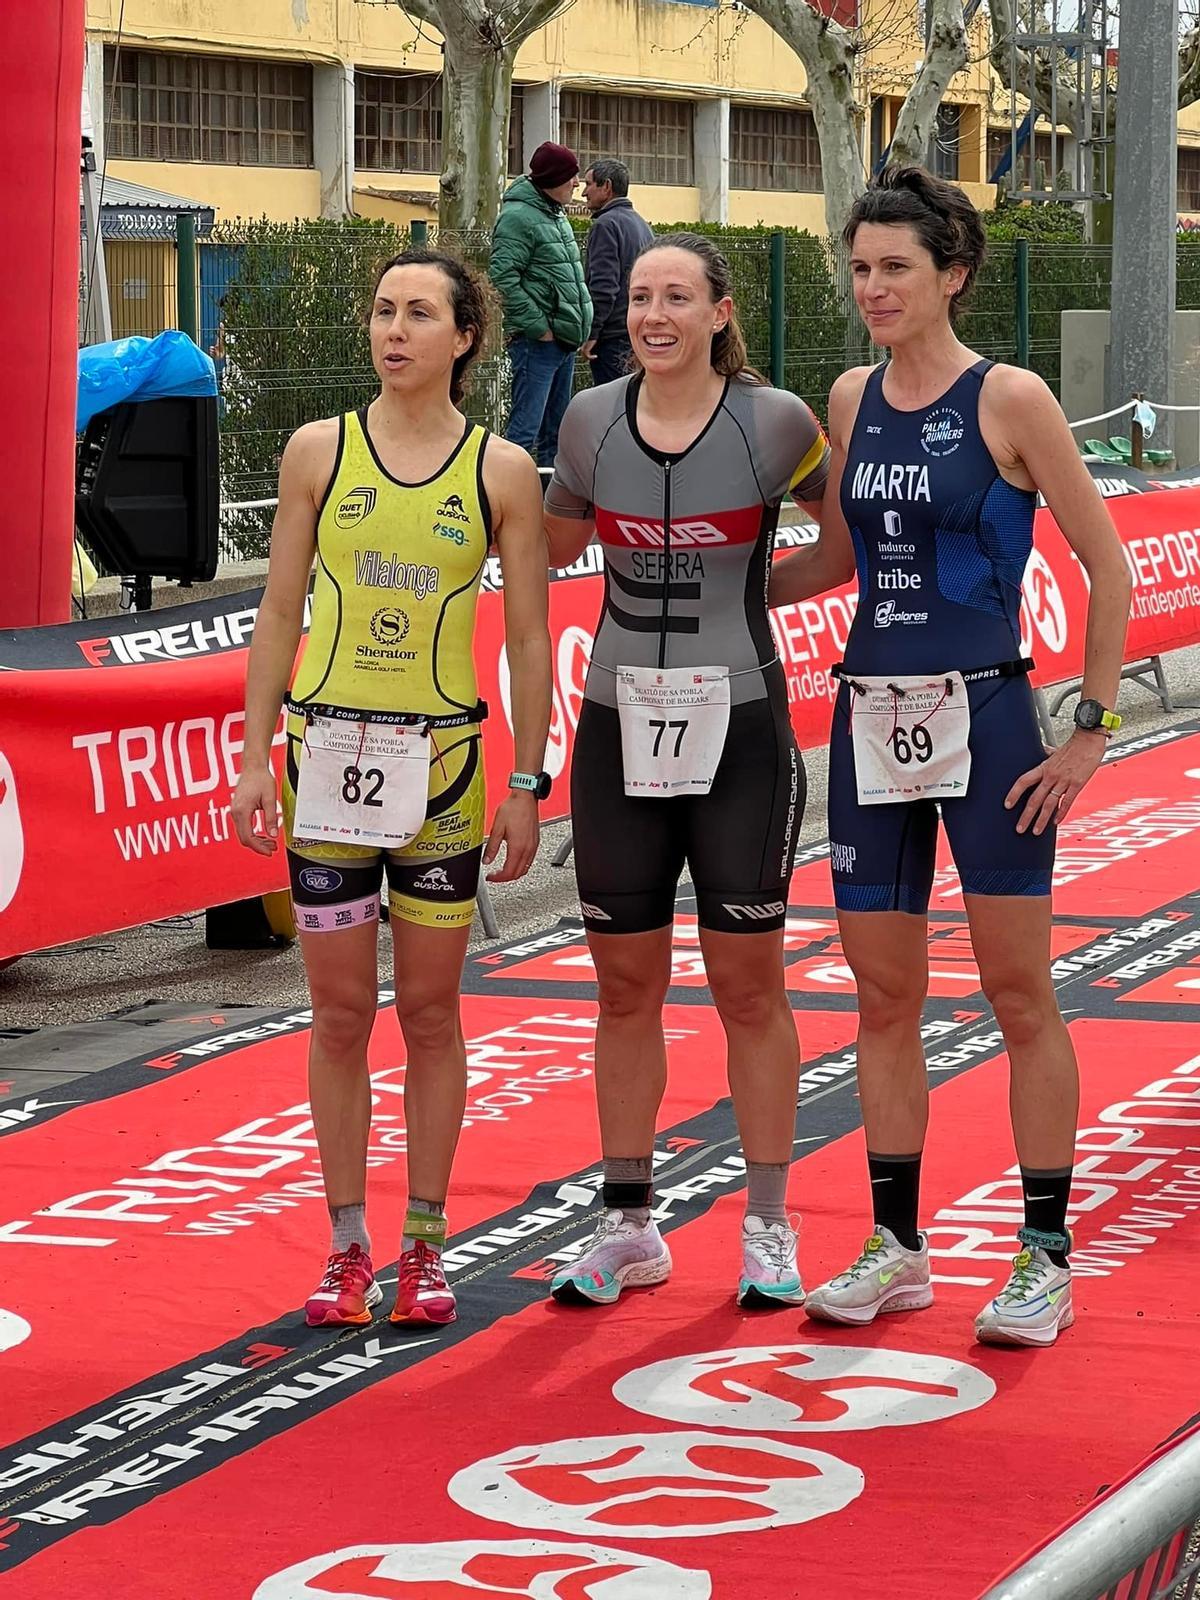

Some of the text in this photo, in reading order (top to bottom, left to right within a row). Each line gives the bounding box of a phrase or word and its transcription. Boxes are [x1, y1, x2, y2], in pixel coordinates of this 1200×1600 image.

[921, 420, 951, 434] PALMA
[925, 428, 964, 443] RUNNERS
[851, 462, 932, 503] MARTA
[339, 503, 363, 512] DUET
[877, 541, 916, 553] indurco
[631, 551, 706, 580] SERRA
[354, 550, 440, 601] Villalonga
[877, 568, 922, 590] tribe
[889, 611, 928, 622] colores
[76, 595, 312, 667] FIREHA
[355, 645, 417, 660] Sheraton
[963, 668, 1000, 682] OMPRES
[659, 689, 668, 697] DE
[917, 692, 940, 700] POBLA
[666, 697, 676, 705] DE
[677, 696, 709, 704] BALEARS
[904, 703, 914, 711] DE
[369, 736, 379, 745] SA
[380, 737, 404, 747] POBLA
[648, 719, 689, 758] 77
[893, 725, 933, 765] 69
[365, 744, 375, 753] DE
[377, 746, 409, 755] BALEARS
[342, 765, 385, 808] 82
[780, 747, 799, 878] MALLORCA CYCLING
[438, 815, 460, 828] BEAT
[335, 909, 352, 918] YES
[435, 913, 462, 921] DUET
